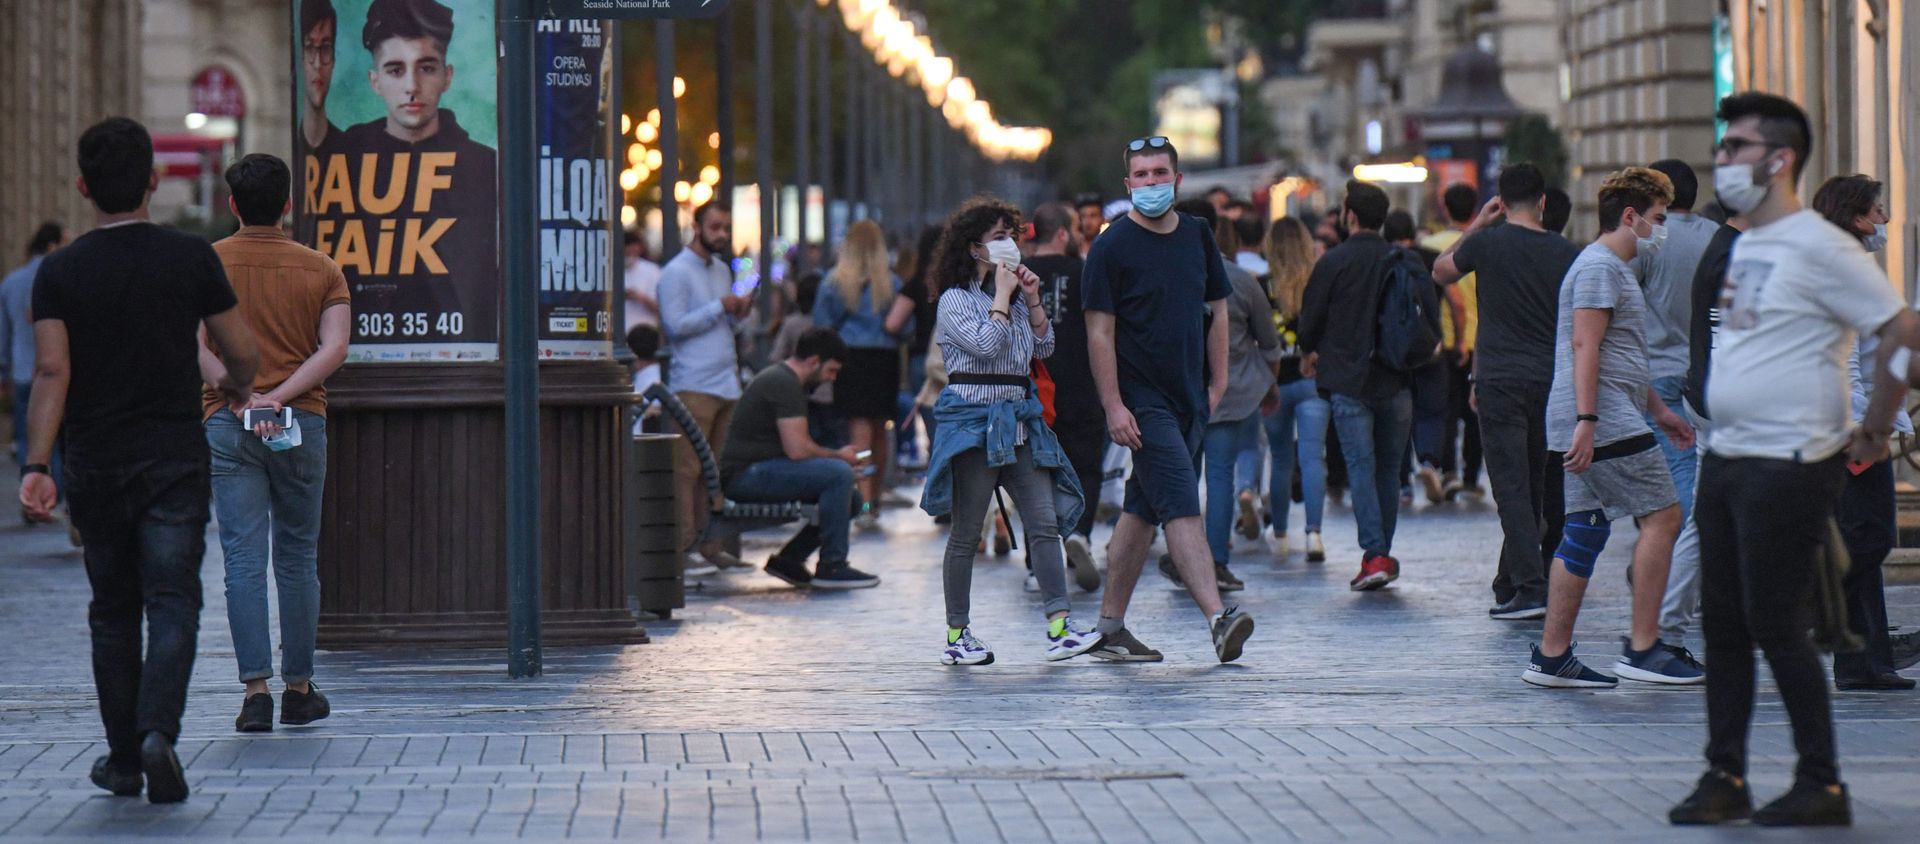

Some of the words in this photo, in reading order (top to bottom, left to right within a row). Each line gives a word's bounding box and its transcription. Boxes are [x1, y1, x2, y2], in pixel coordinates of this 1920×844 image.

[583, 0, 613, 9] Seaside
[615, 0, 650, 9] National
[652, 0, 671, 8] Park
[553, 56, 586, 70] OPERA
[304, 151, 457, 215] RAUF
[358, 313, 395, 336] 303
[402, 312, 428, 335] 35
[436, 311, 464, 335] 40
